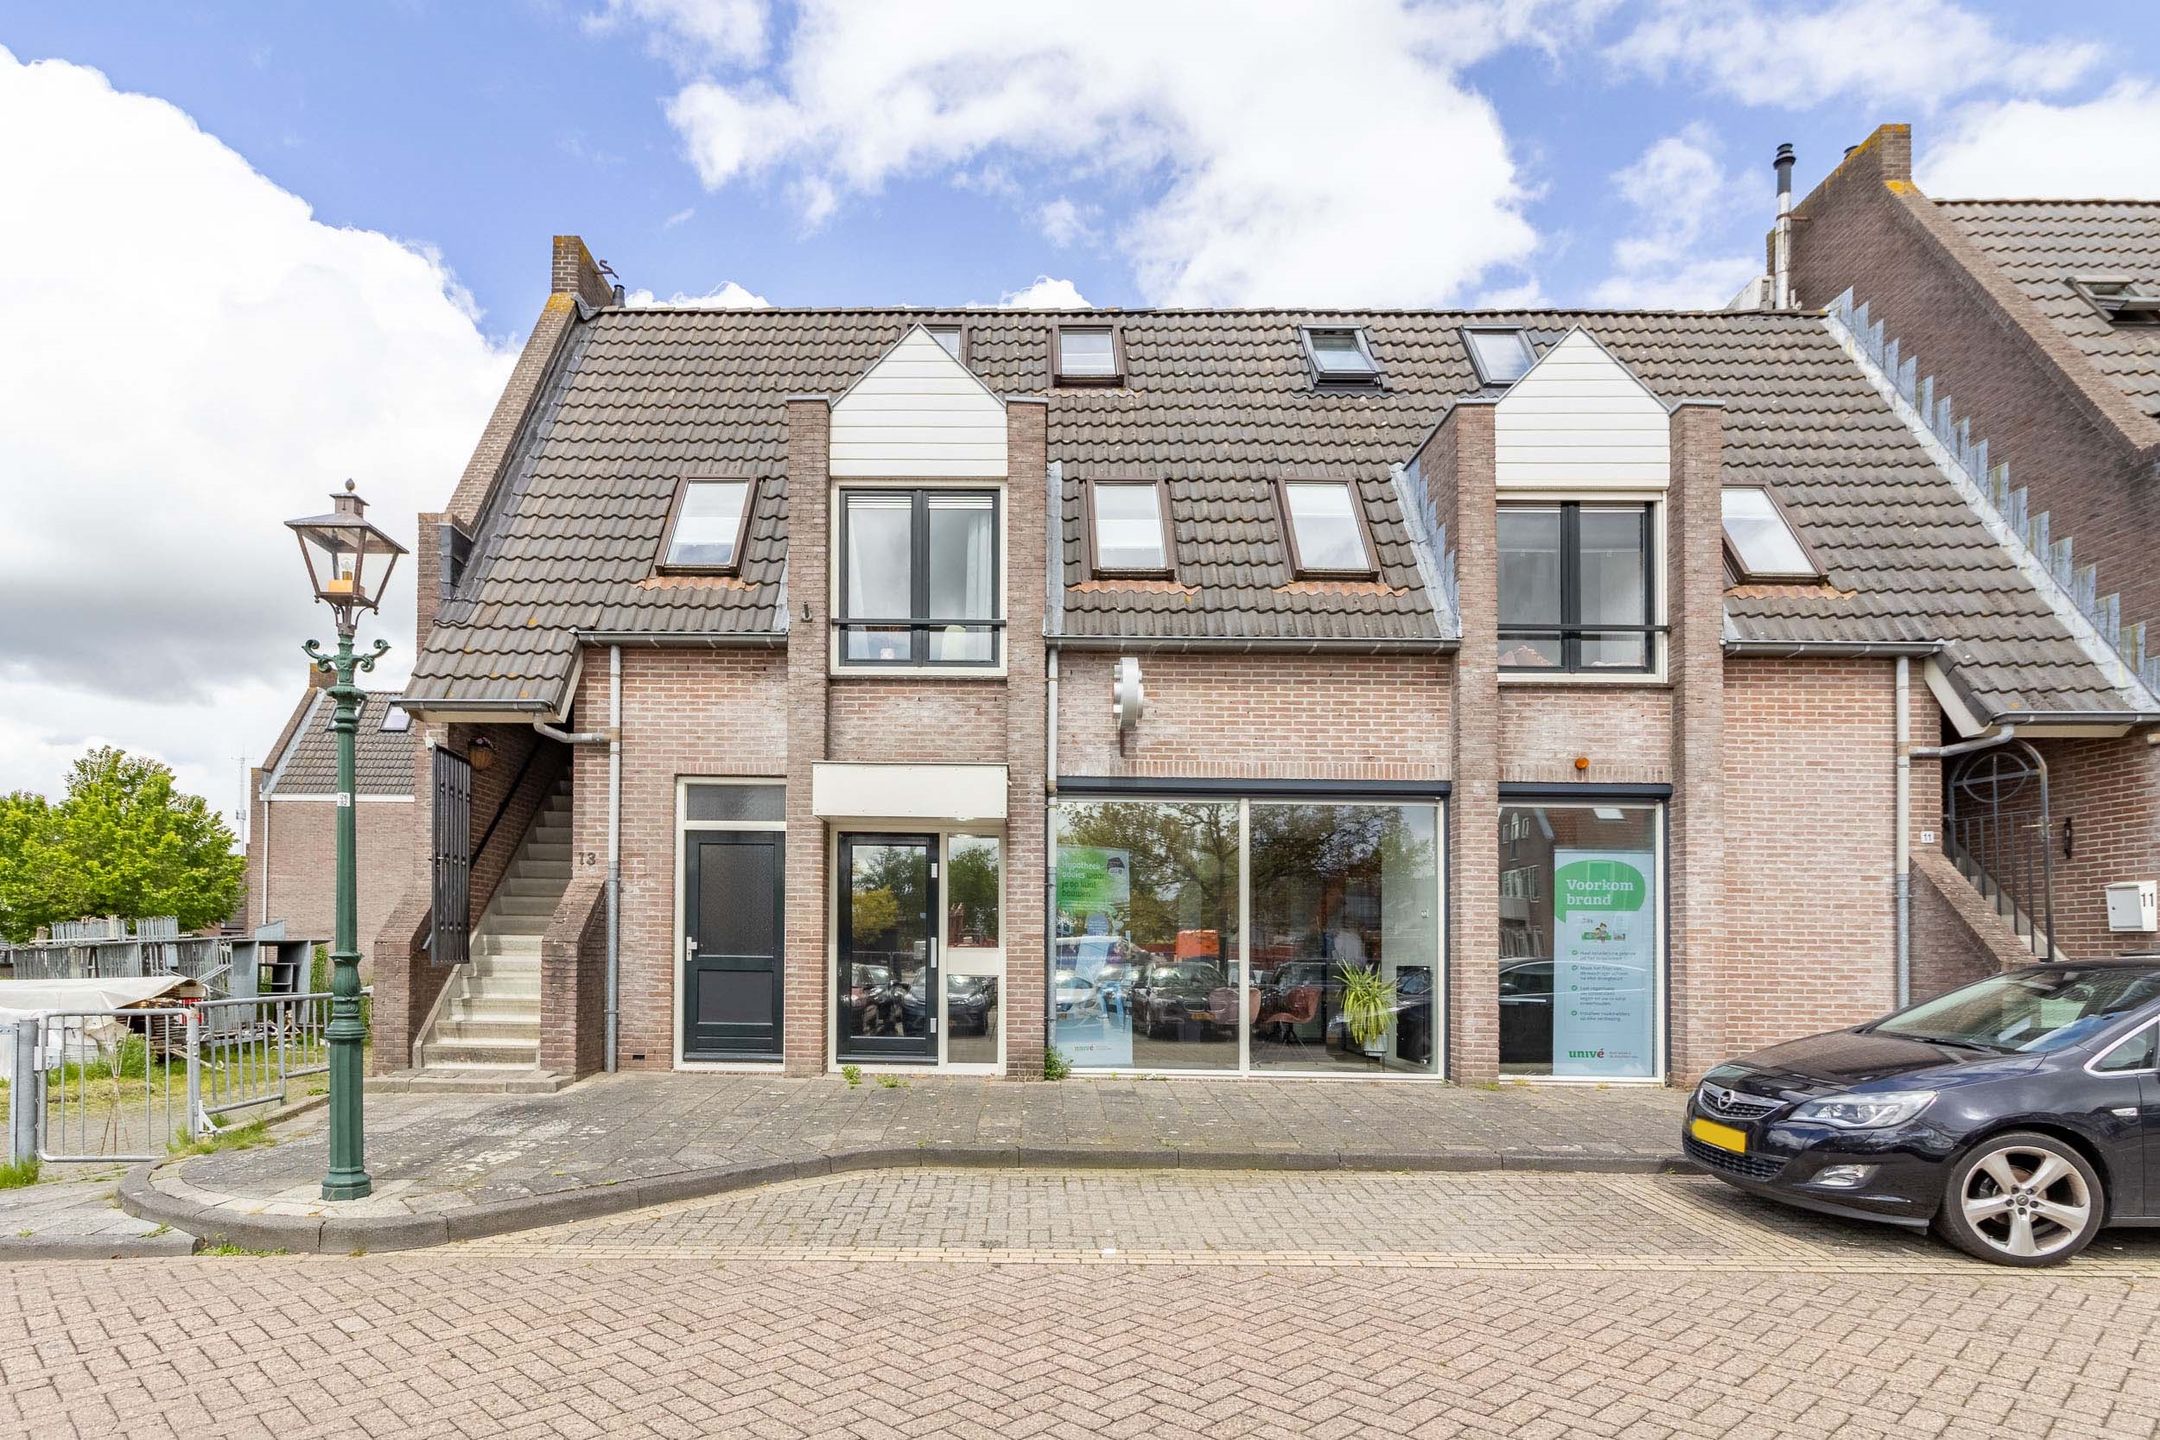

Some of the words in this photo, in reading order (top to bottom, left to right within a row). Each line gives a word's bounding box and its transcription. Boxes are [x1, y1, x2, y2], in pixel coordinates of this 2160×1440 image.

[578, 852, 596, 865] 13
[1566, 879, 1634, 891] Voorkom
[1566, 893, 1611, 905] brand
[2140, 892, 2154, 907] 11
[1568, 1047, 1605, 1059] univé
